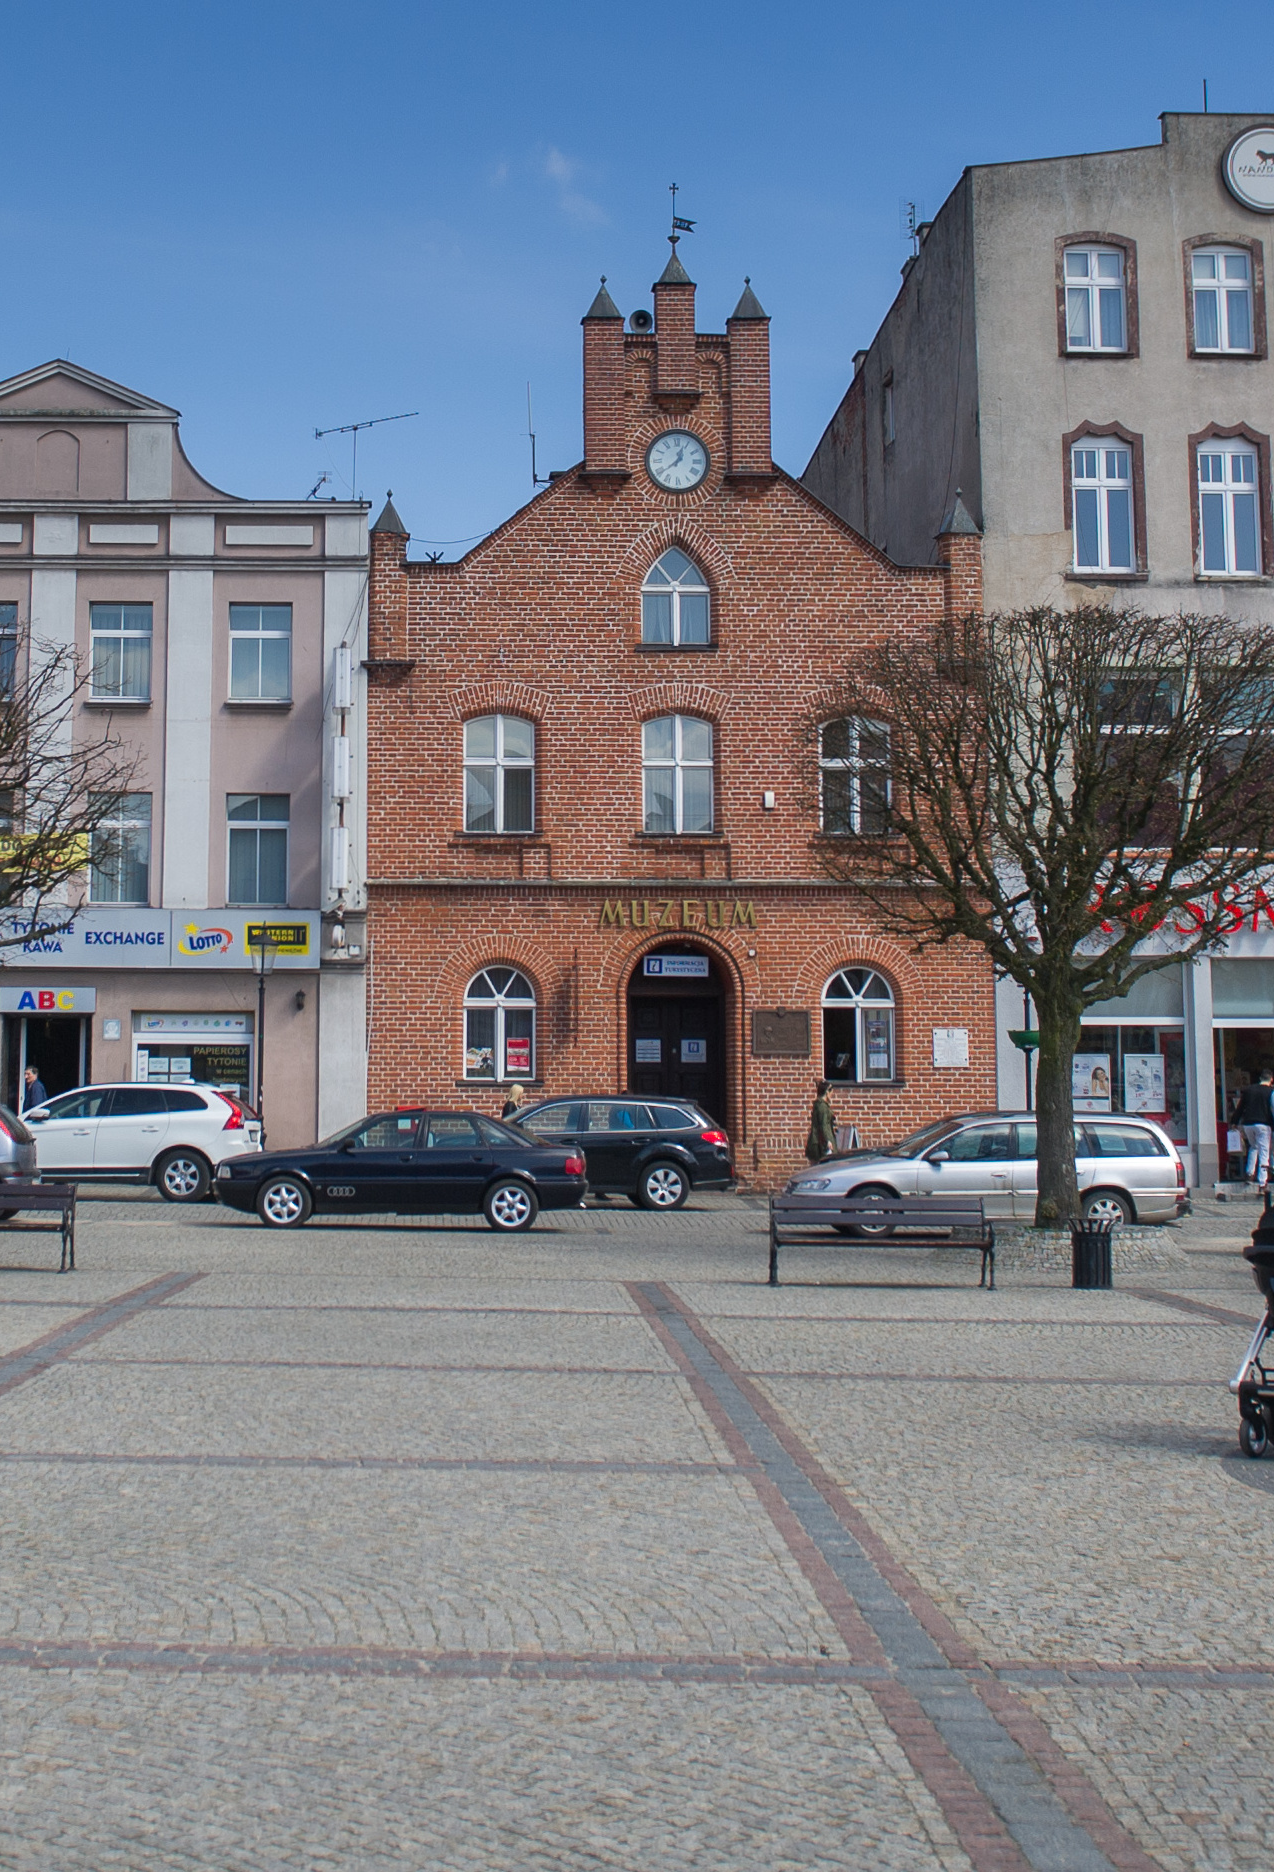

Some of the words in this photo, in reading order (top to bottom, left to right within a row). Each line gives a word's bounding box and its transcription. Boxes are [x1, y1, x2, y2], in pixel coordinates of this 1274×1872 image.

[600, 899, 758, 927] MUZEUM
[85, 931, 165, 946] EXCHANGE
[189, 933, 223, 951] LOTTO
[24, 941, 63, 953] KAWA
[17, 991, 74, 1010] ABC
[193, 1046, 247, 1056] PAPIEROSY
[207, 1057, 247, 1066] TYTONIE
